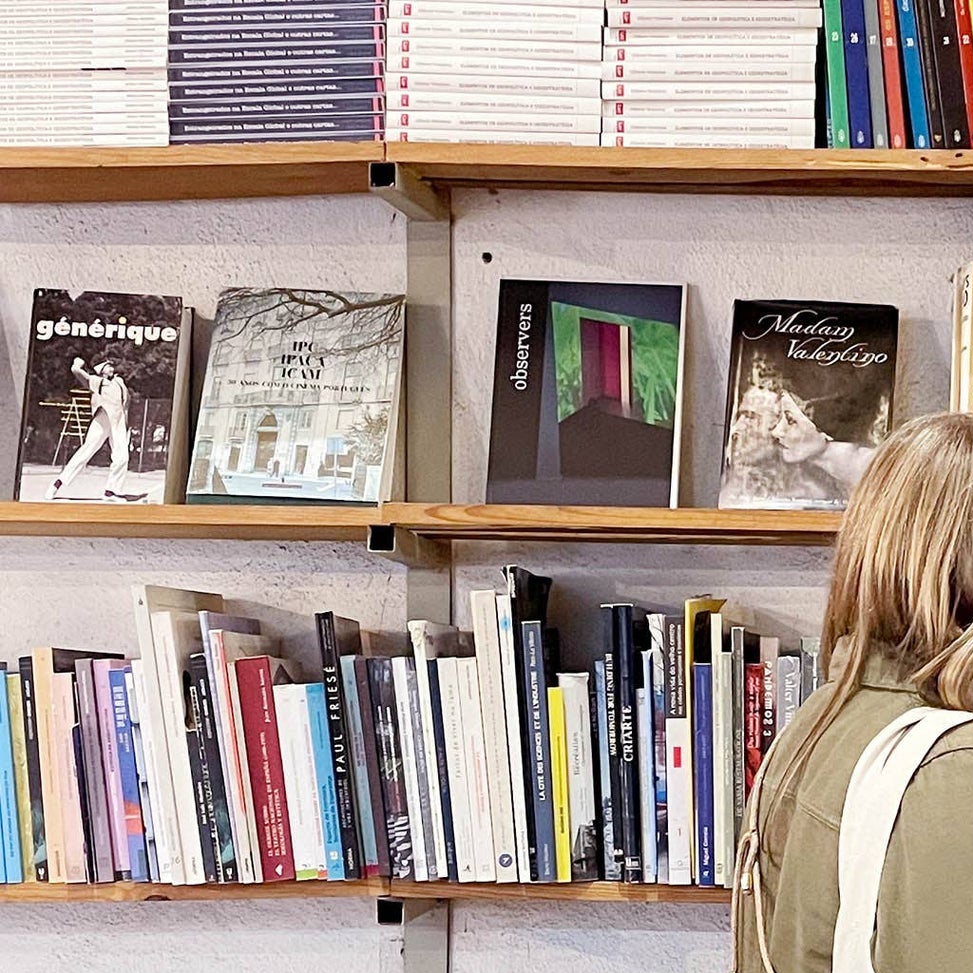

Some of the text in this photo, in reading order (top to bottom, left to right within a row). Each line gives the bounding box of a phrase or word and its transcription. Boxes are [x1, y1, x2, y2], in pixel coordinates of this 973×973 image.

[849, 33, 859, 44] 26
[36, 317, 177, 346] générique
[742, 309, 856, 341] Madam
[509, 303, 533, 391] observers
[786, 337, 889, 368] Valentino
[668, 623, 676, 645] centro
[668, 666, 676, 675] do
[530, 670, 541, 709] L'INDUSTRIE
[323, 665, 347, 773] PAUL FRIESÉ
[532, 709, 541, 720] DE
[604, 652, 617, 757] BUILDING FOR TOMORROW
[533, 721, 541, 730] ET
[621, 704, 634, 762] CRIARTE
[535, 731, 544, 761] SCIENCES
[536, 775, 546, 790] CITÉ
[539, 789, 547, 801] LA
[702, 848, 710, 866] Miguel
